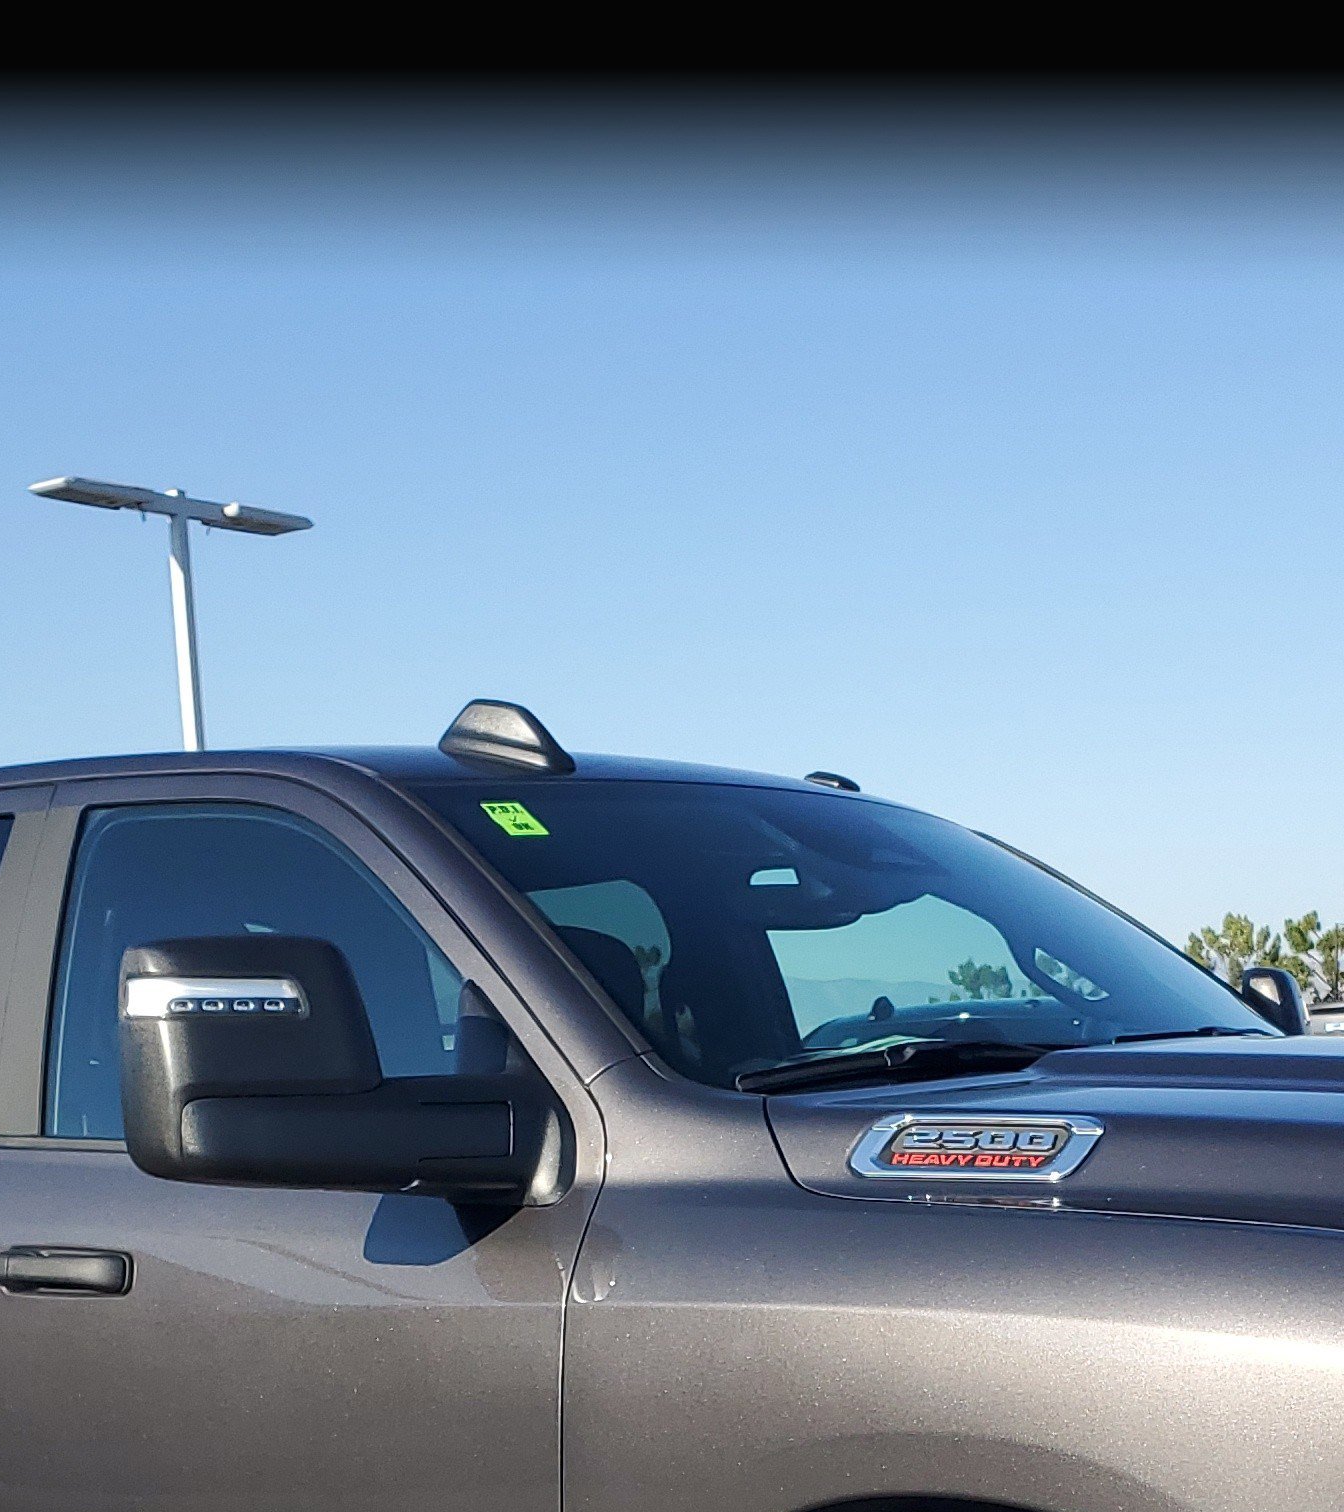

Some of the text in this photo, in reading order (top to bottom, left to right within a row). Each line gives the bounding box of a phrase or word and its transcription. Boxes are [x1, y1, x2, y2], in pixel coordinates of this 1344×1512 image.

[902, 1127, 1059, 1151] 2500
[891, 1153, 1046, 1167] HEAVY DUTY
